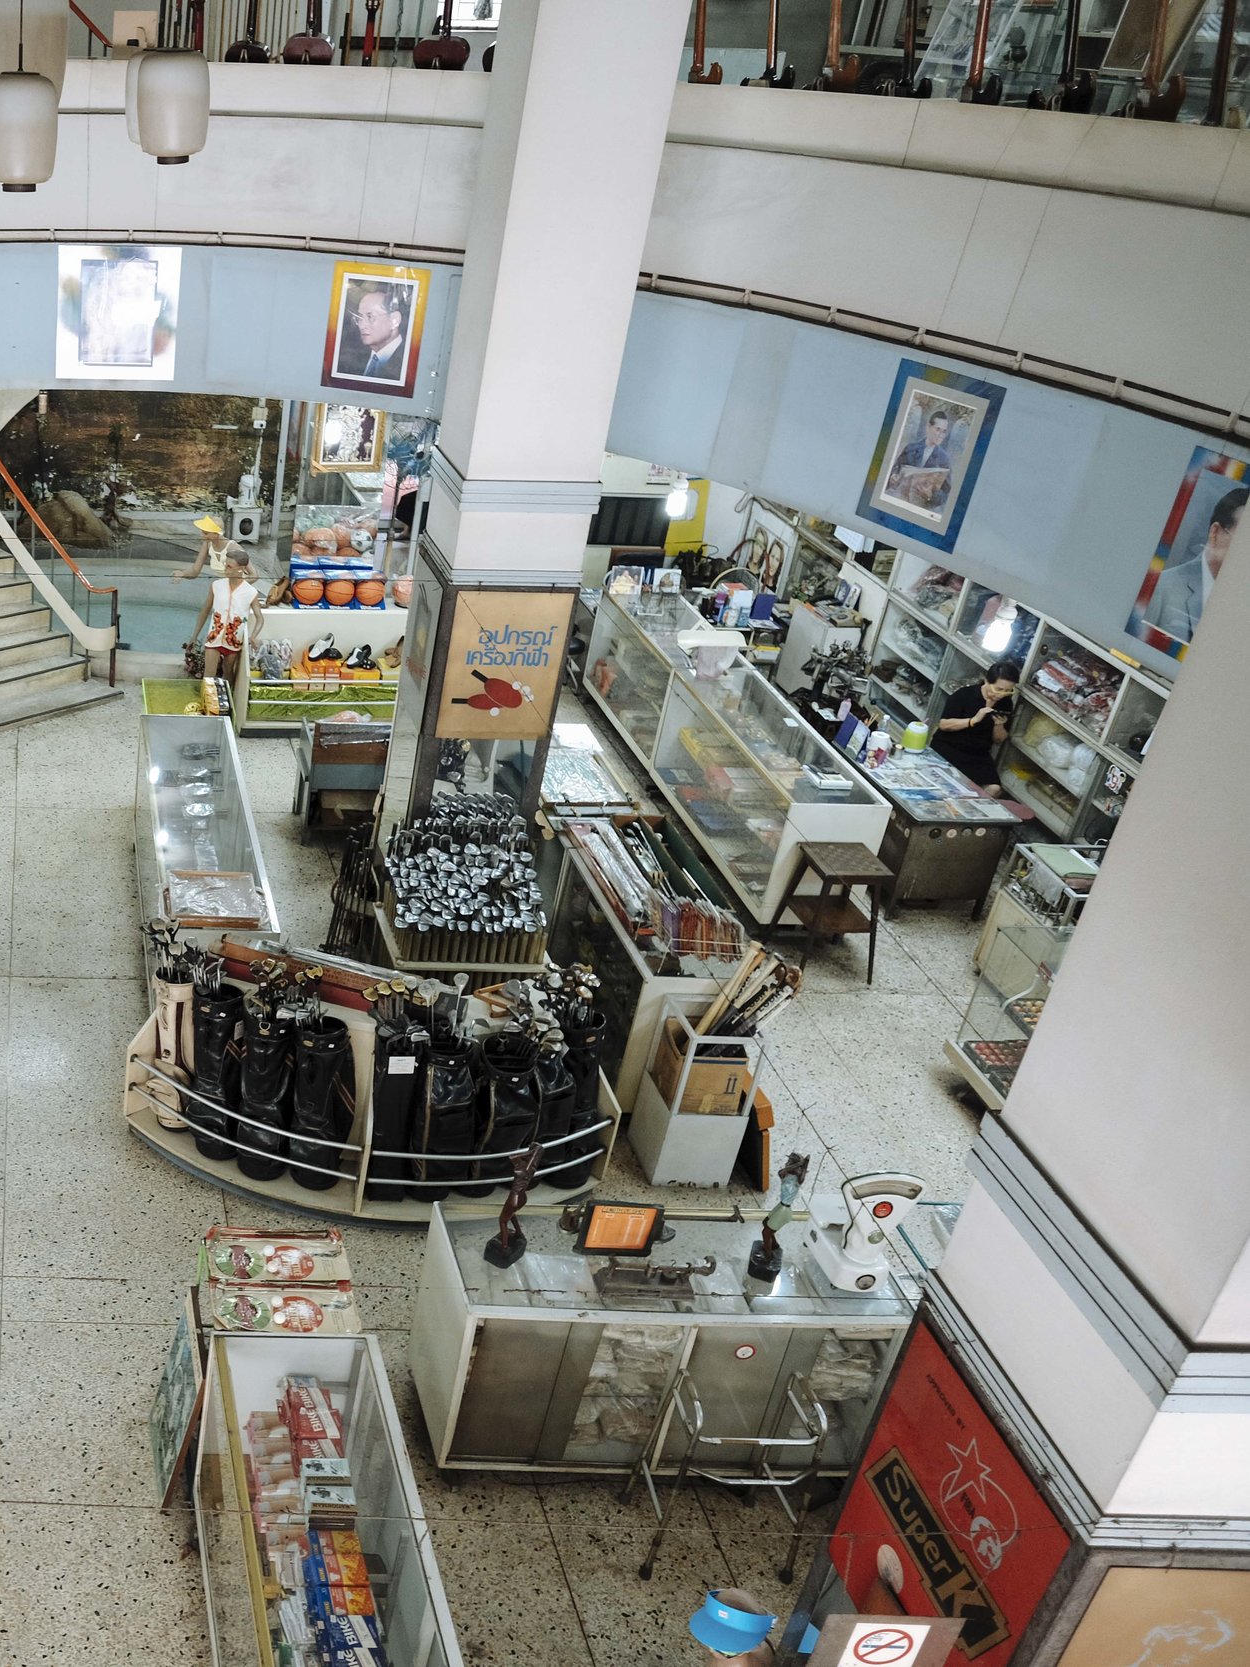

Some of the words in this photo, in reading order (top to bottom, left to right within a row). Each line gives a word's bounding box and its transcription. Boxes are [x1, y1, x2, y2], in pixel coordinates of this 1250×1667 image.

[478, 624, 558, 648] อุปกรณ์
[298, 1385, 315, 1409] BIKE
[306, 1407, 324, 1432] BIKE
[336, 1616, 359, 1646] BIKE
[343, 1648, 360, 1667] IKE
